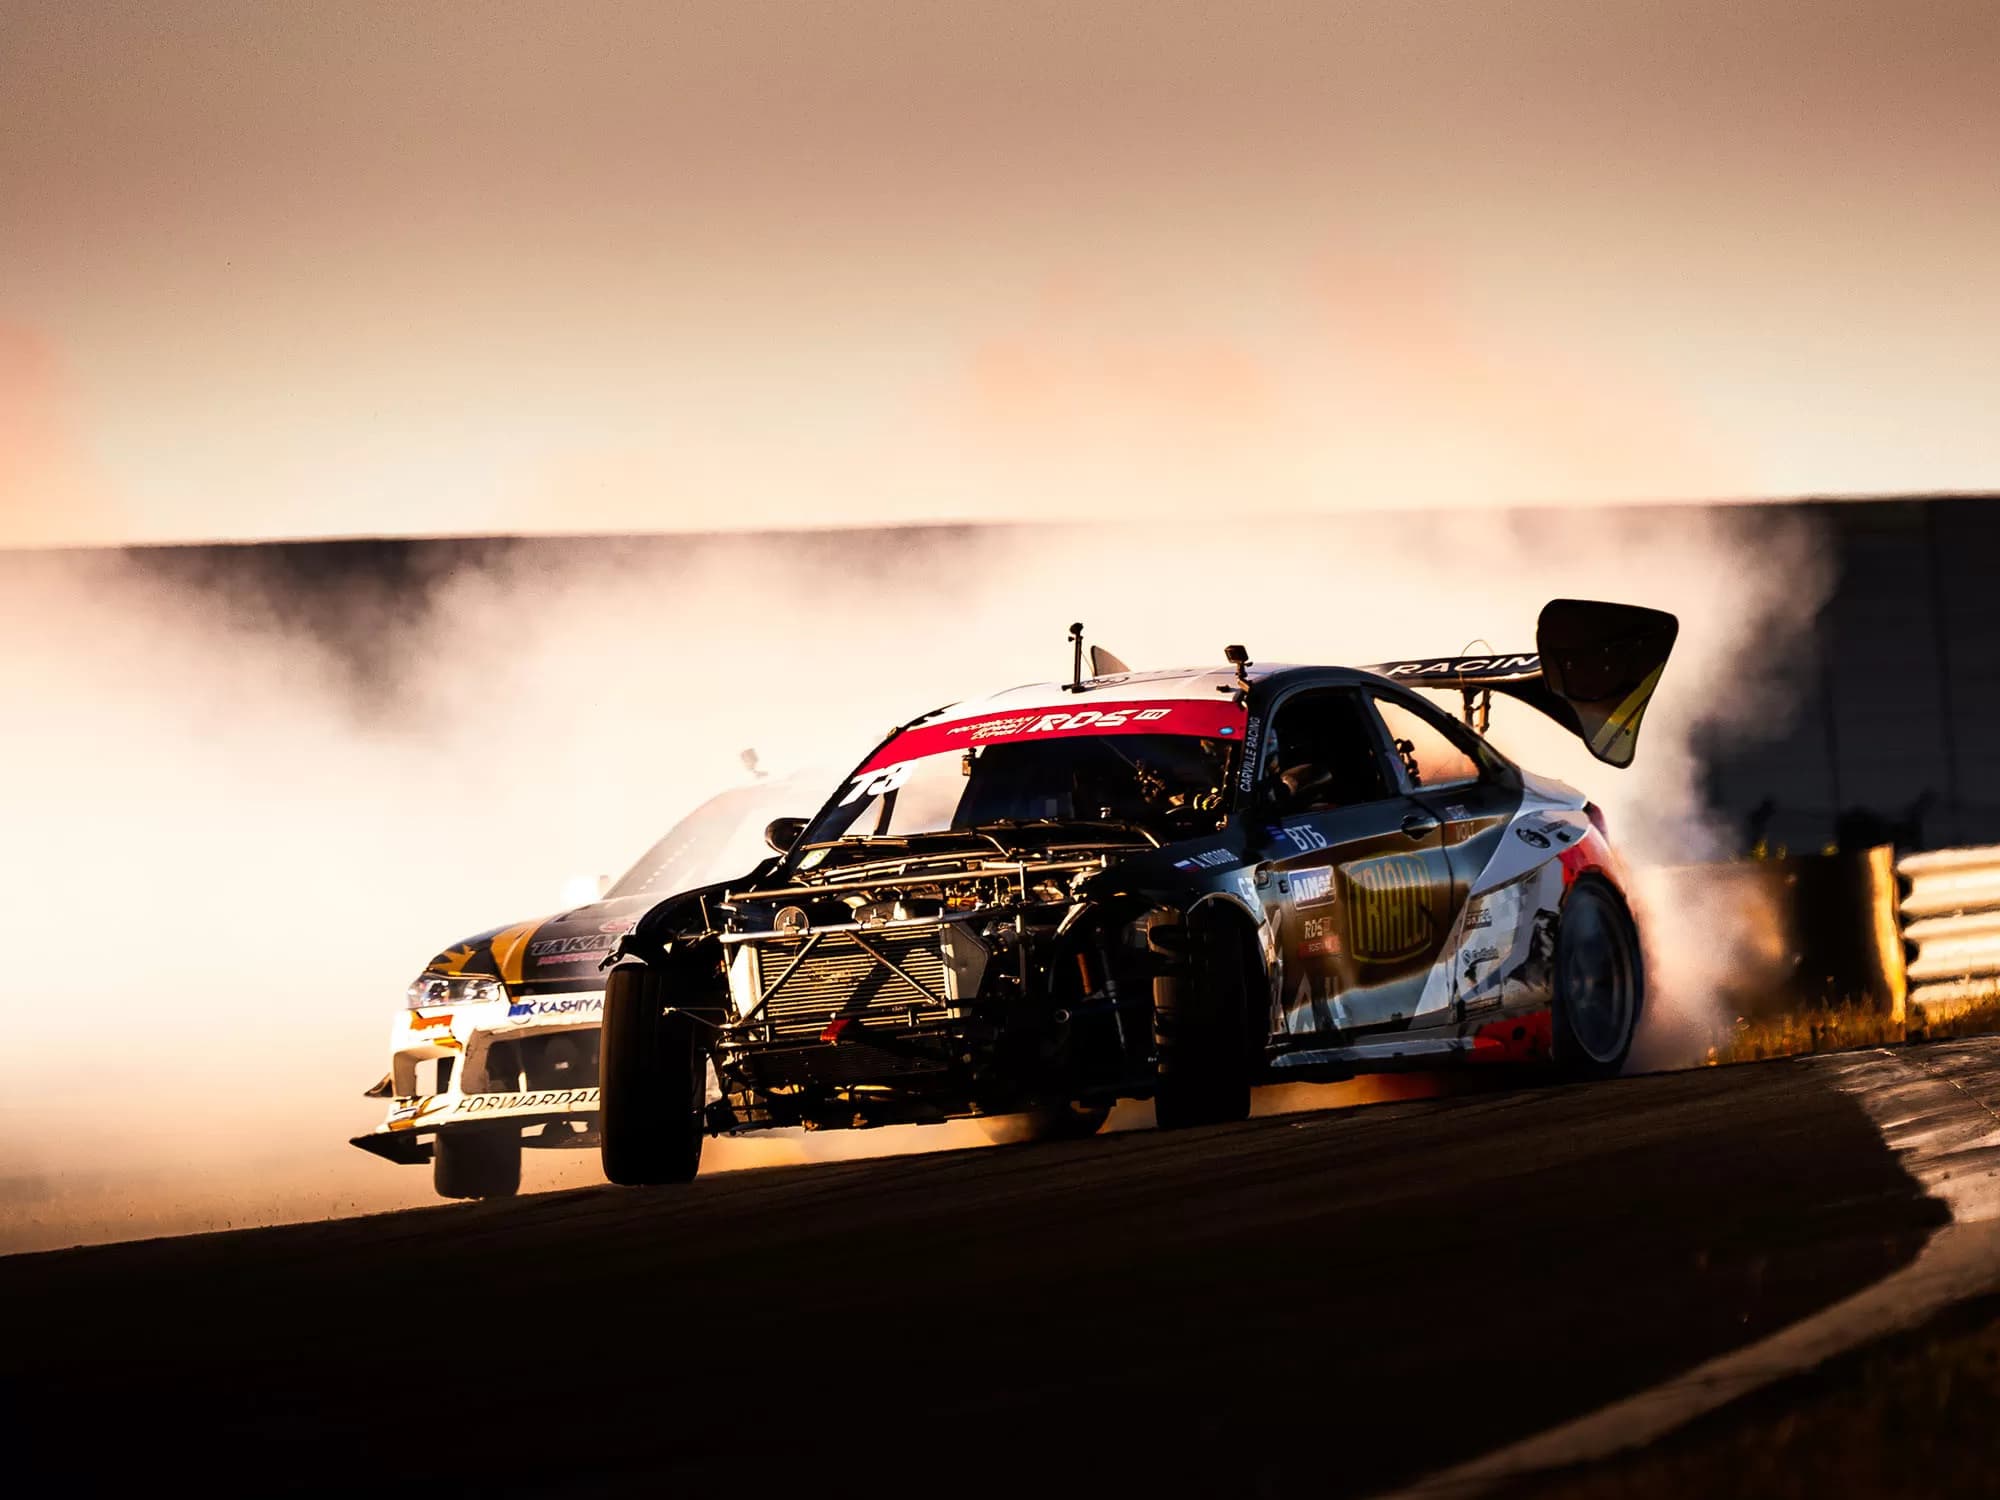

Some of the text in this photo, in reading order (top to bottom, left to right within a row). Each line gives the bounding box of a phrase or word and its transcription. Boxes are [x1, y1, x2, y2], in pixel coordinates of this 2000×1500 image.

[1386, 655, 1540, 676] RACIN
[1026, 710, 1140, 733] RDS
[1240, 716, 1261, 792] CARVILLE RACING
